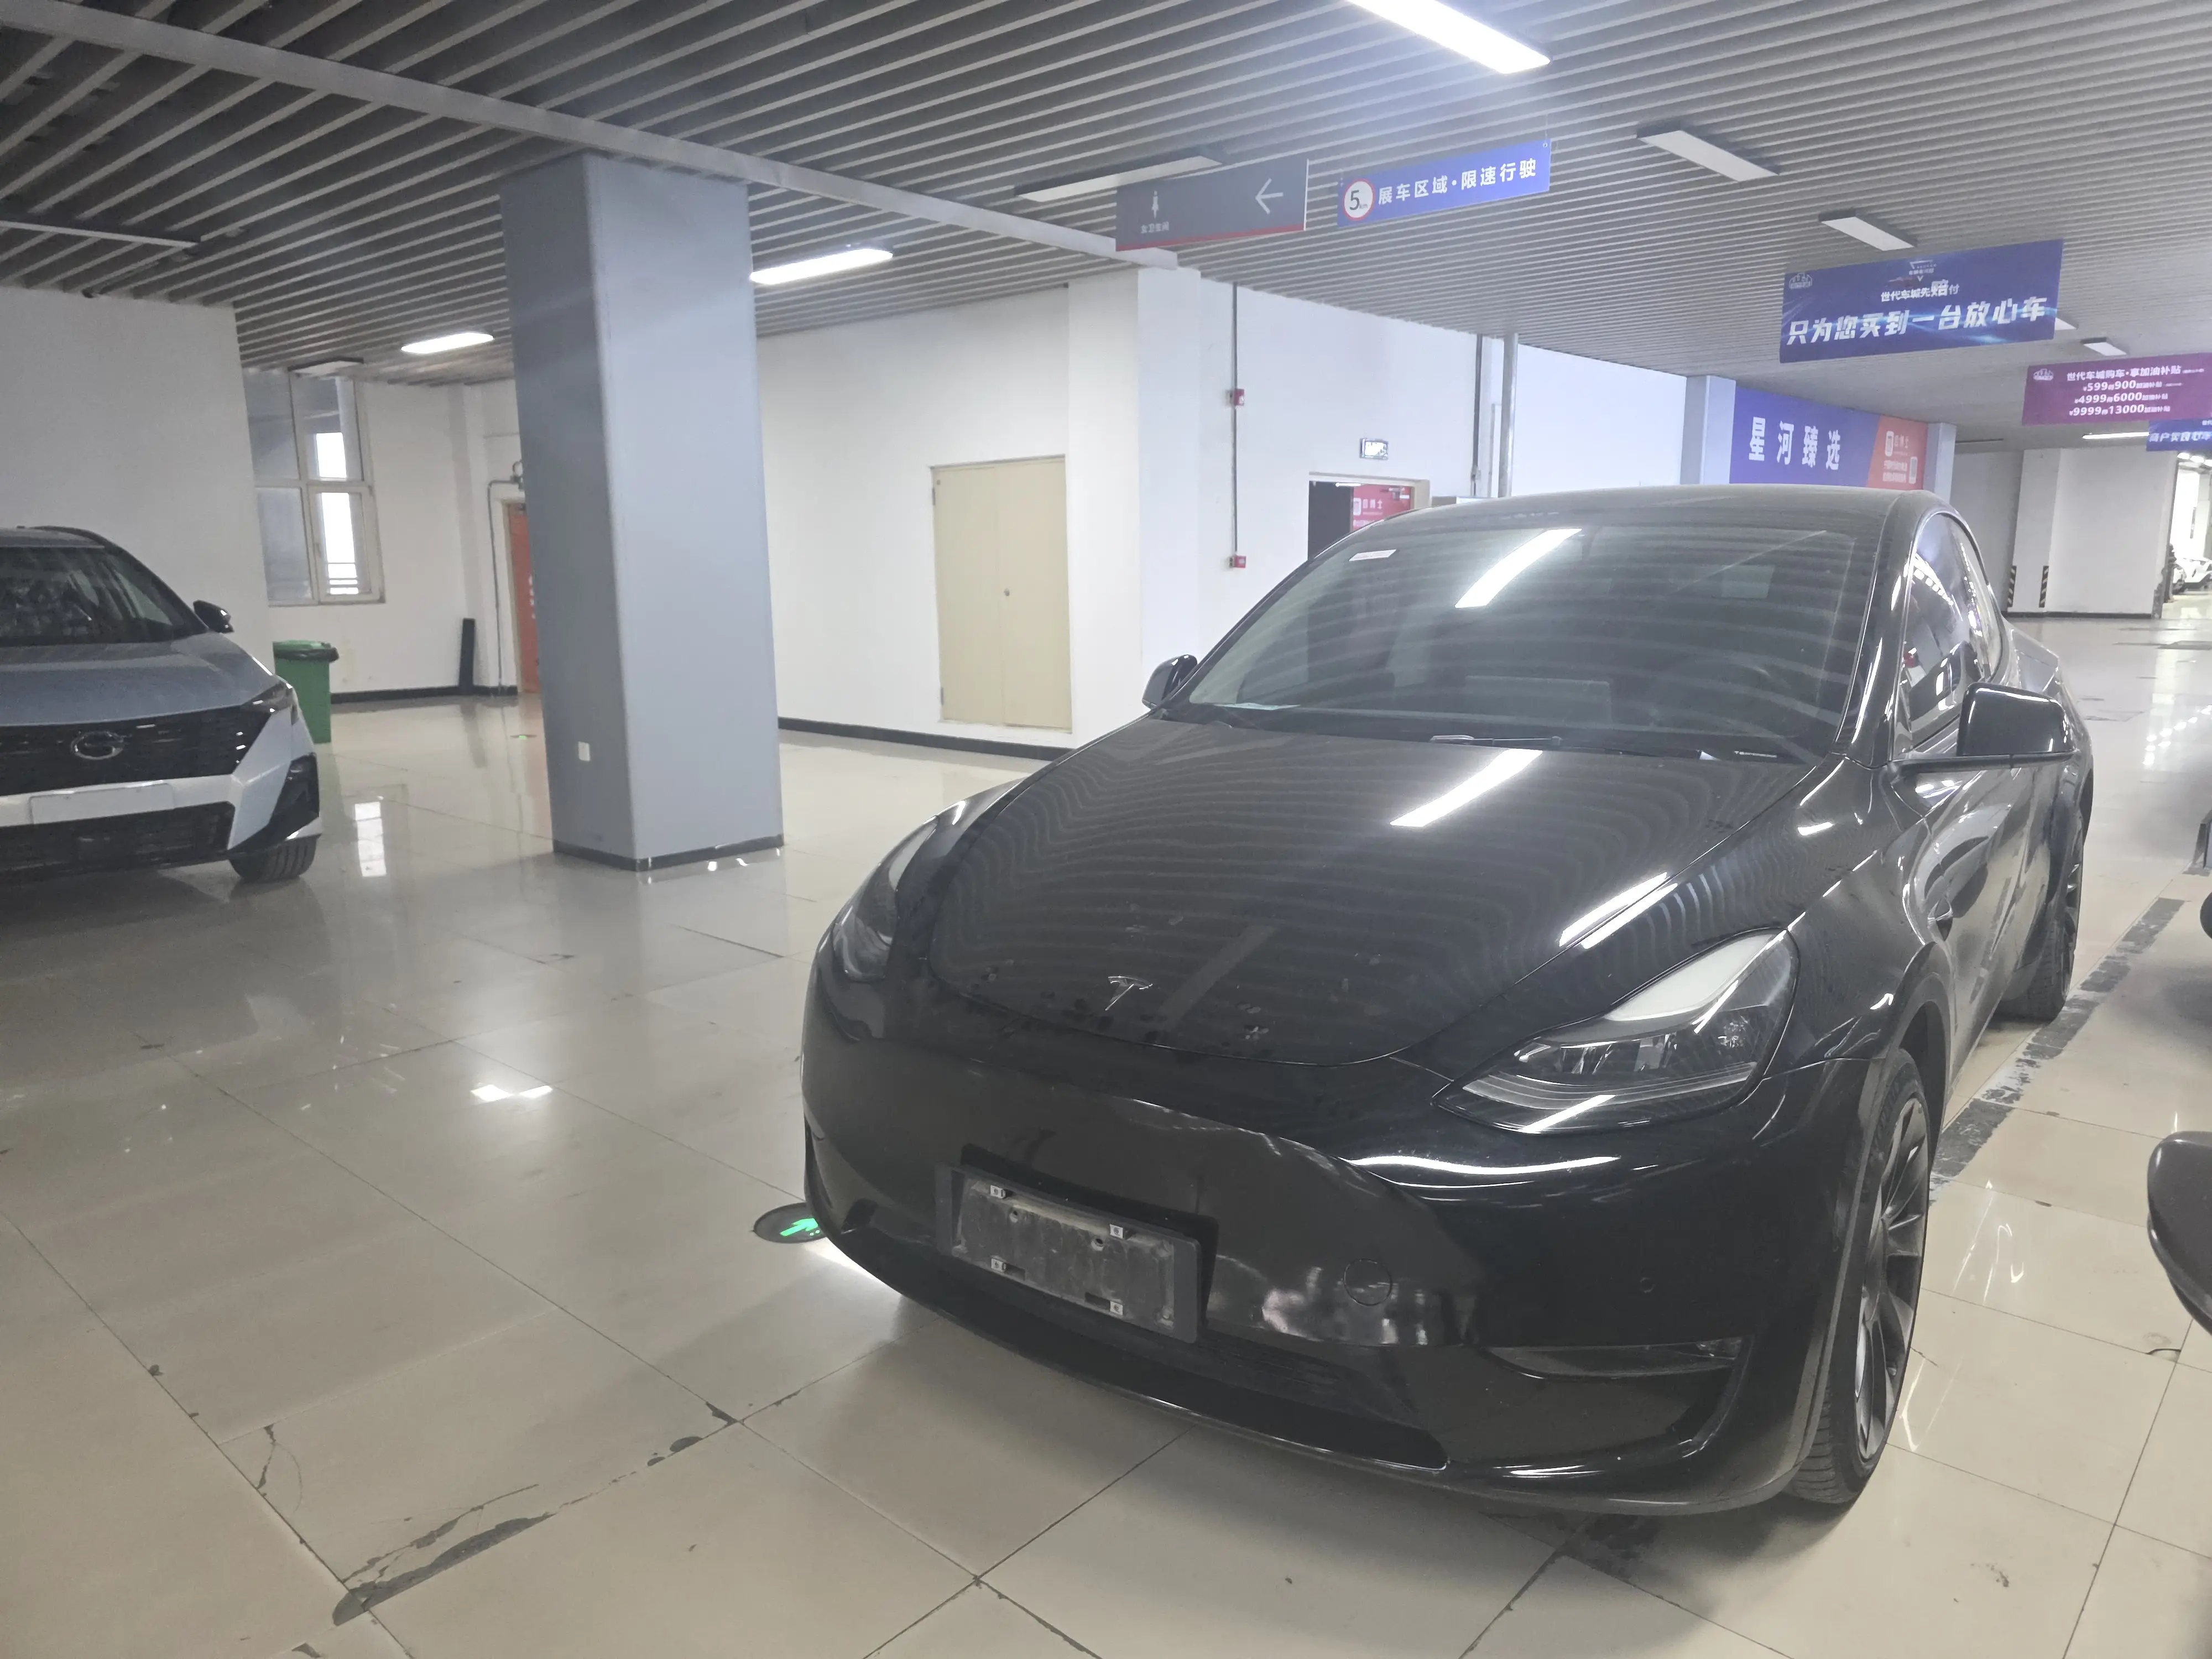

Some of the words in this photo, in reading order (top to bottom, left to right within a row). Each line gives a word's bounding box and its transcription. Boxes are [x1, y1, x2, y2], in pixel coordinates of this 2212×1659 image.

[1379, 158, 1536, 205] 展车区域·限速行驶
[1786, 296, 2047, 345] 只为您买到一台放心车
[1749, 416, 1840, 470] 星河臻选
